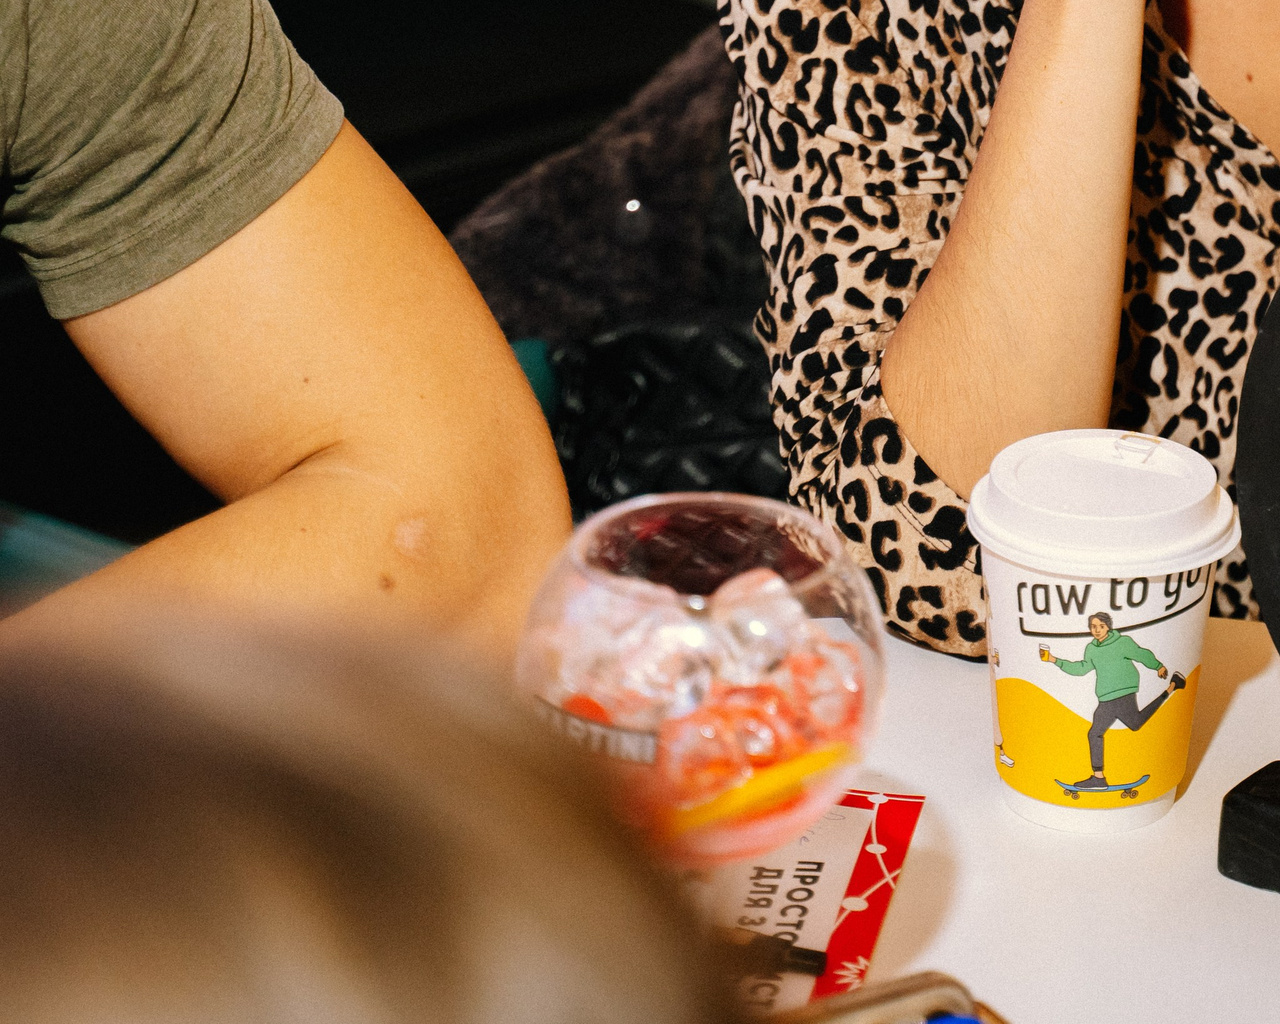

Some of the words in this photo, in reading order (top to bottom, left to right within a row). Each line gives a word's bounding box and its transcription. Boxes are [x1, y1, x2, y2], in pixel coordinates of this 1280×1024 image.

[1017, 581, 1093, 616] raw
[1109, 576, 1150, 612] to
[533, 701, 658, 765] ARTINI
[744, 866, 785, 909] ДЛЯ
